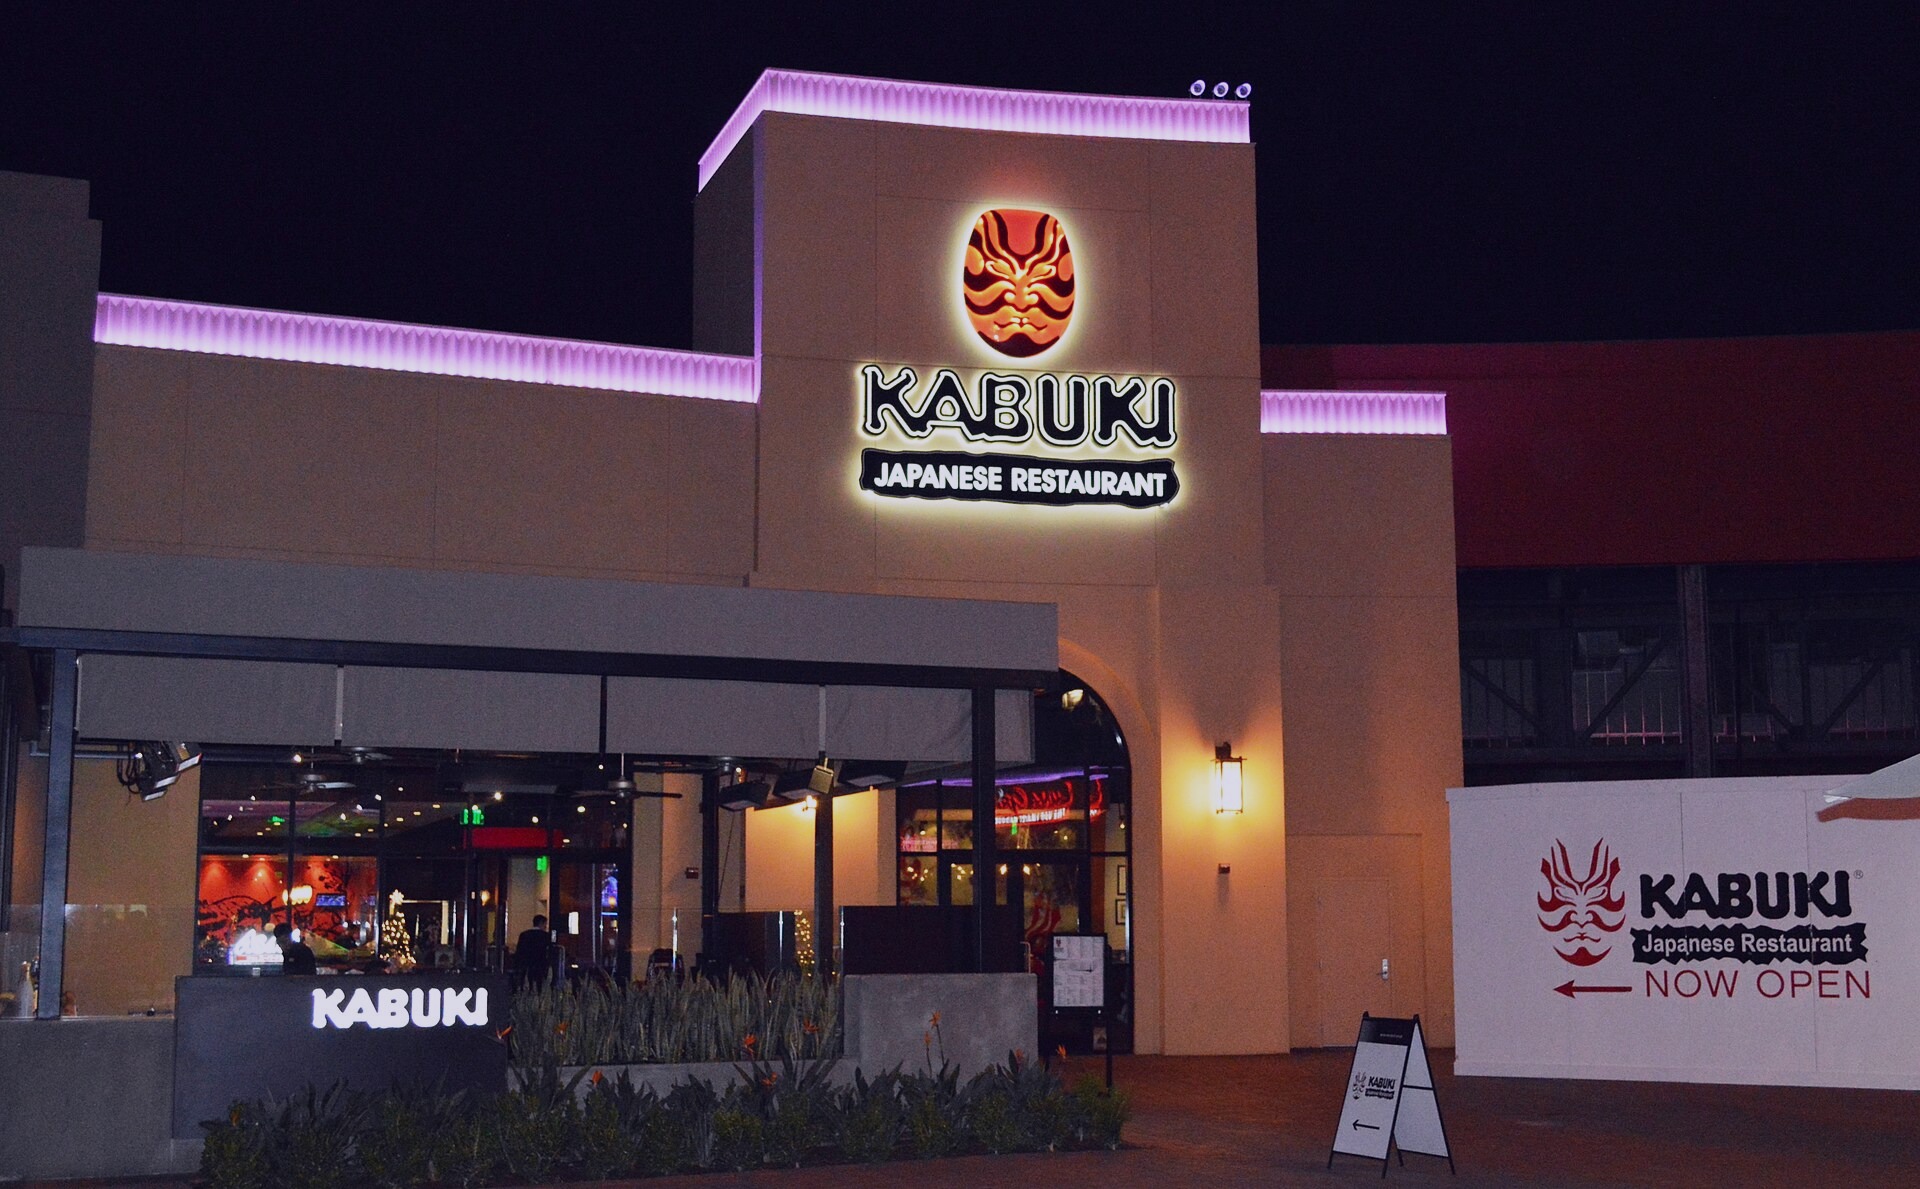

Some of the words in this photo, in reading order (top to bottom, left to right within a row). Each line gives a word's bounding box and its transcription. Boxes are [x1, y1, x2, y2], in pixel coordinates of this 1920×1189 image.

[862, 364, 1178, 448] KABUKI
[874, 462, 1002, 491] JAPANESE
[1011, 467, 1167, 497] RESTAURANT
[1639, 870, 1852, 920] KABUKI
[1641, 933, 1735, 957] Japanese
[1741, 932, 1853, 954] Restaurant
[1645, 969, 1740, 998] NOW
[1756, 969, 1871, 999] OPEN
[311, 986, 489, 1029] KABUKI
[1368, 1076, 1396, 1089] KABUKI
